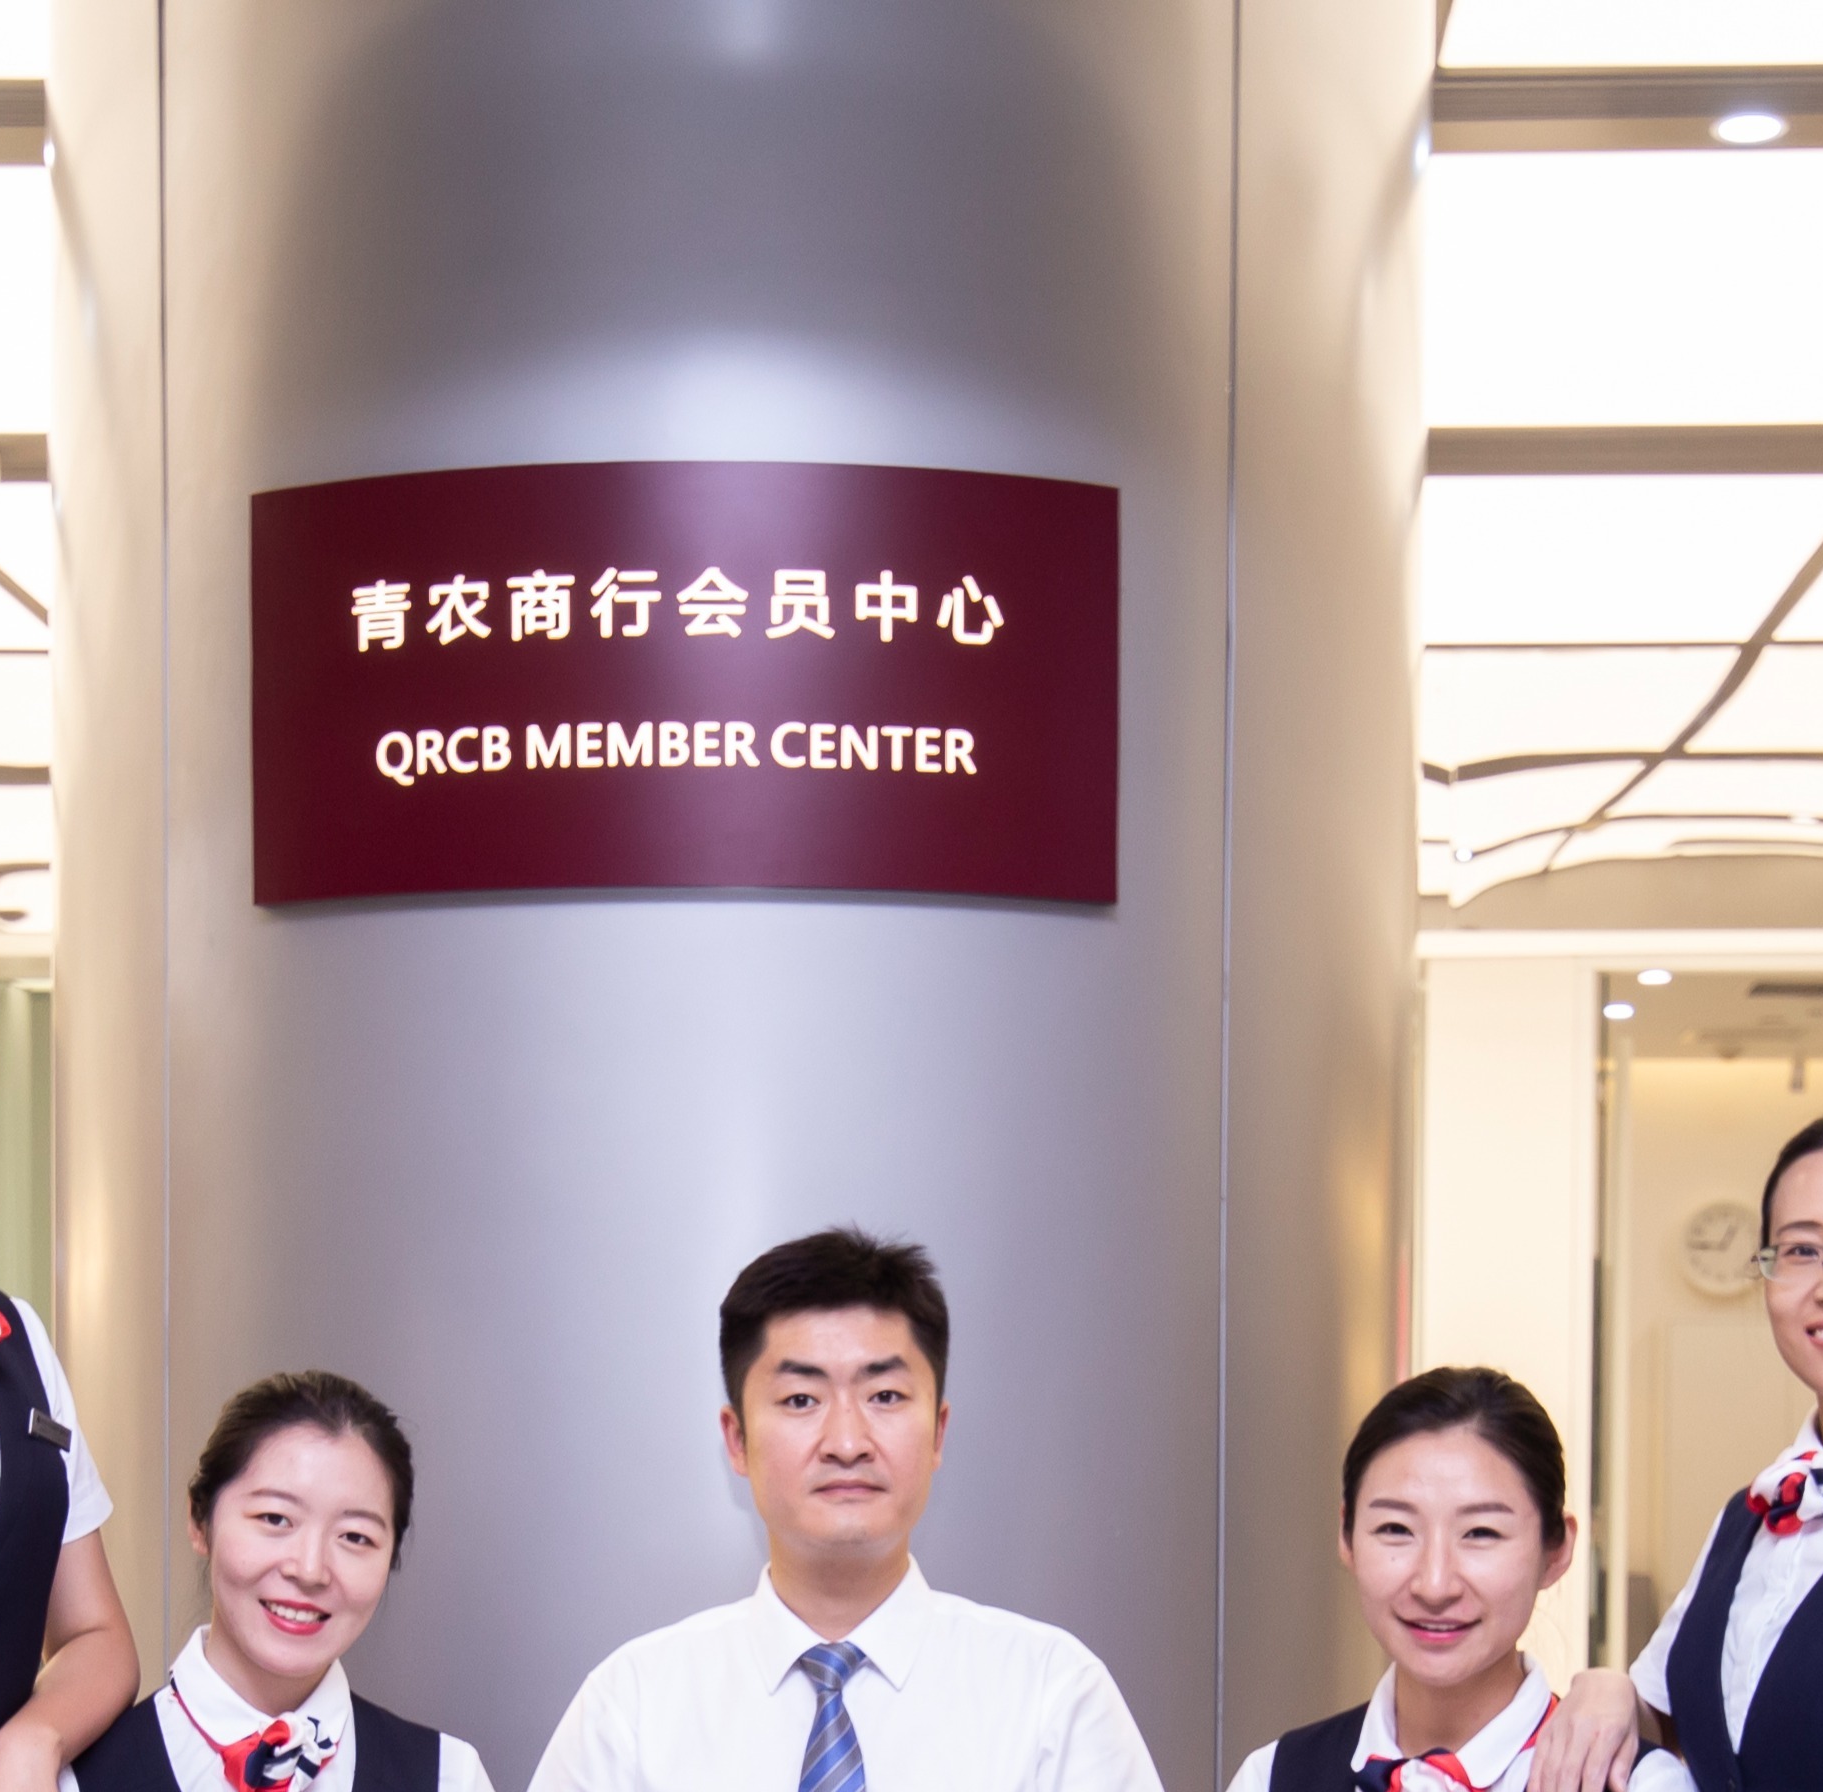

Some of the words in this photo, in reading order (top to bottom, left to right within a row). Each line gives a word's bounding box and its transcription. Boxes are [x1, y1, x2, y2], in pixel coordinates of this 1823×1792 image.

[351, 566, 1005, 653] 青农商行会员中心
[375, 725, 512, 787] QRCB
[525, 721, 760, 770] MEMBER
[770, 721, 977, 775] CENTER
